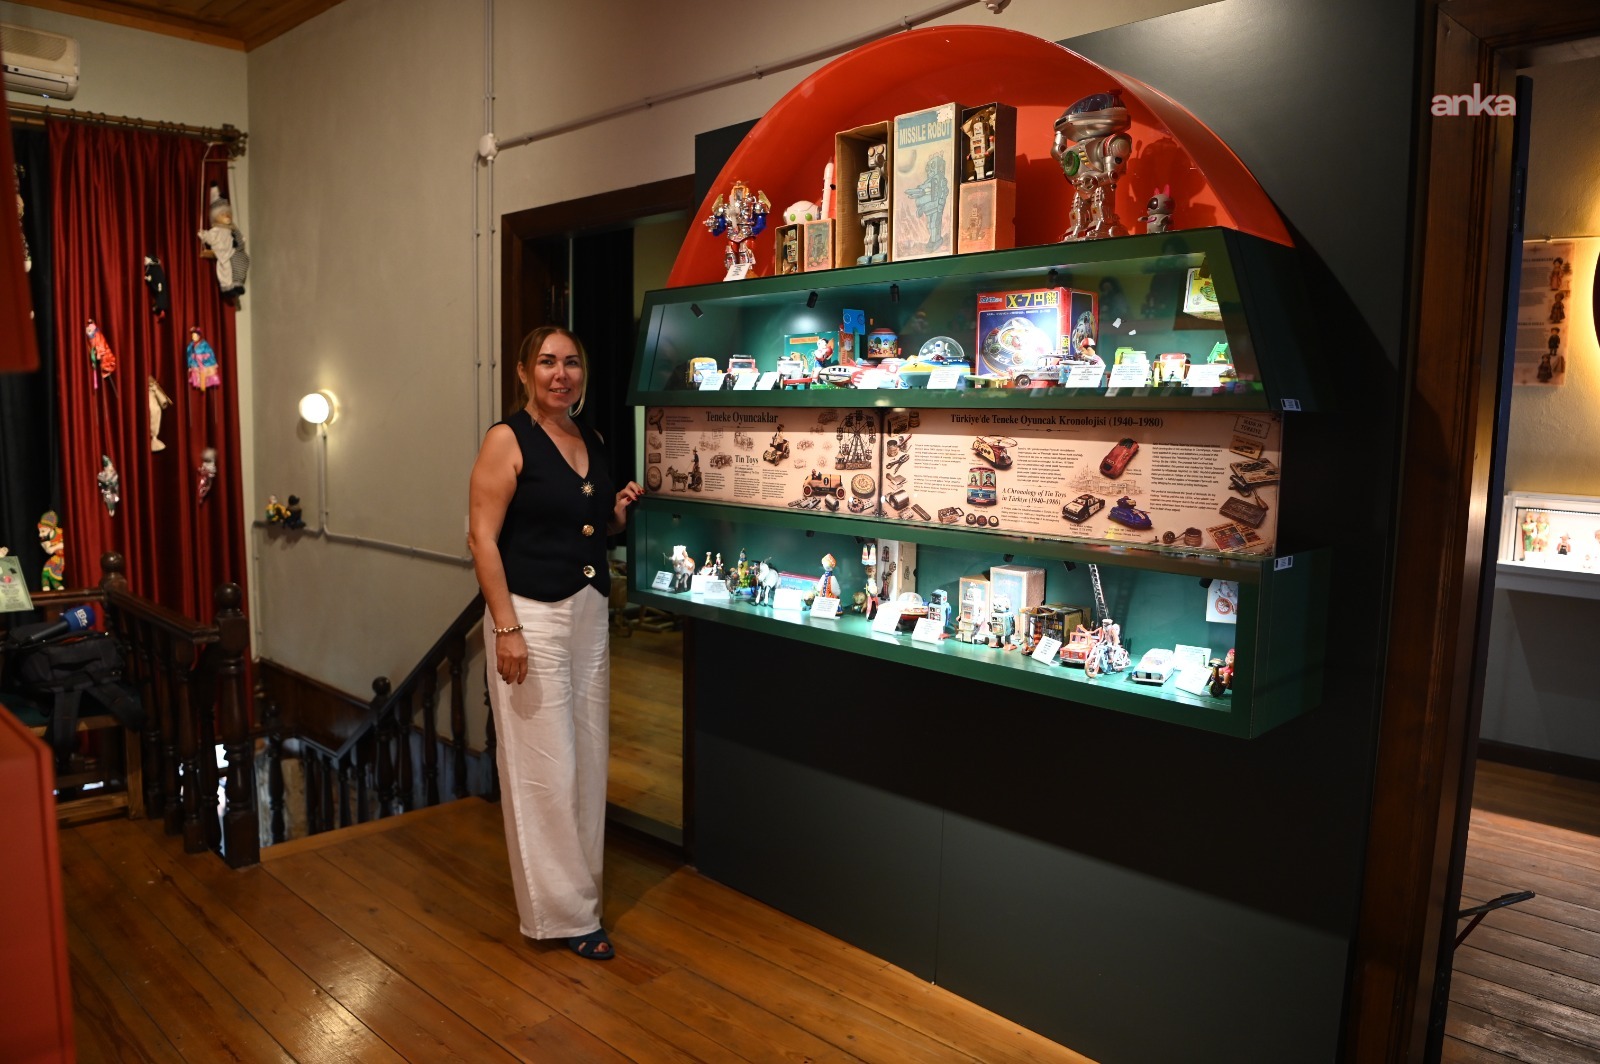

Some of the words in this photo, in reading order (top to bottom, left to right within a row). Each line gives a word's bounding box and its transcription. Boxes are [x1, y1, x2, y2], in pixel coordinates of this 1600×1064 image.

[900, 125, 926, 146] MISSILE
[928, 120, 951, 140] ROBOT
[706, 411, 731, 423] Teneke
[733, 411, 778, 425] Oyuncaklar
[951, 414, 990, 426] Türkiye'de
[992, 415, 1019, 425] Teneke
[1020, 416, 1057, 427] Oyuncak
[1059, 416, 1107, 428] Kronolojisi
[735, 455, 745, 464] Tin
[746, 455, 758, 465] Toys
[1007, 487, 1037, 497] Chronology
[1038, 489, 1044, 497] of
[1054, 490, 1067, 499] Toys
[1008, 495, 1028, 504] Türkiye
